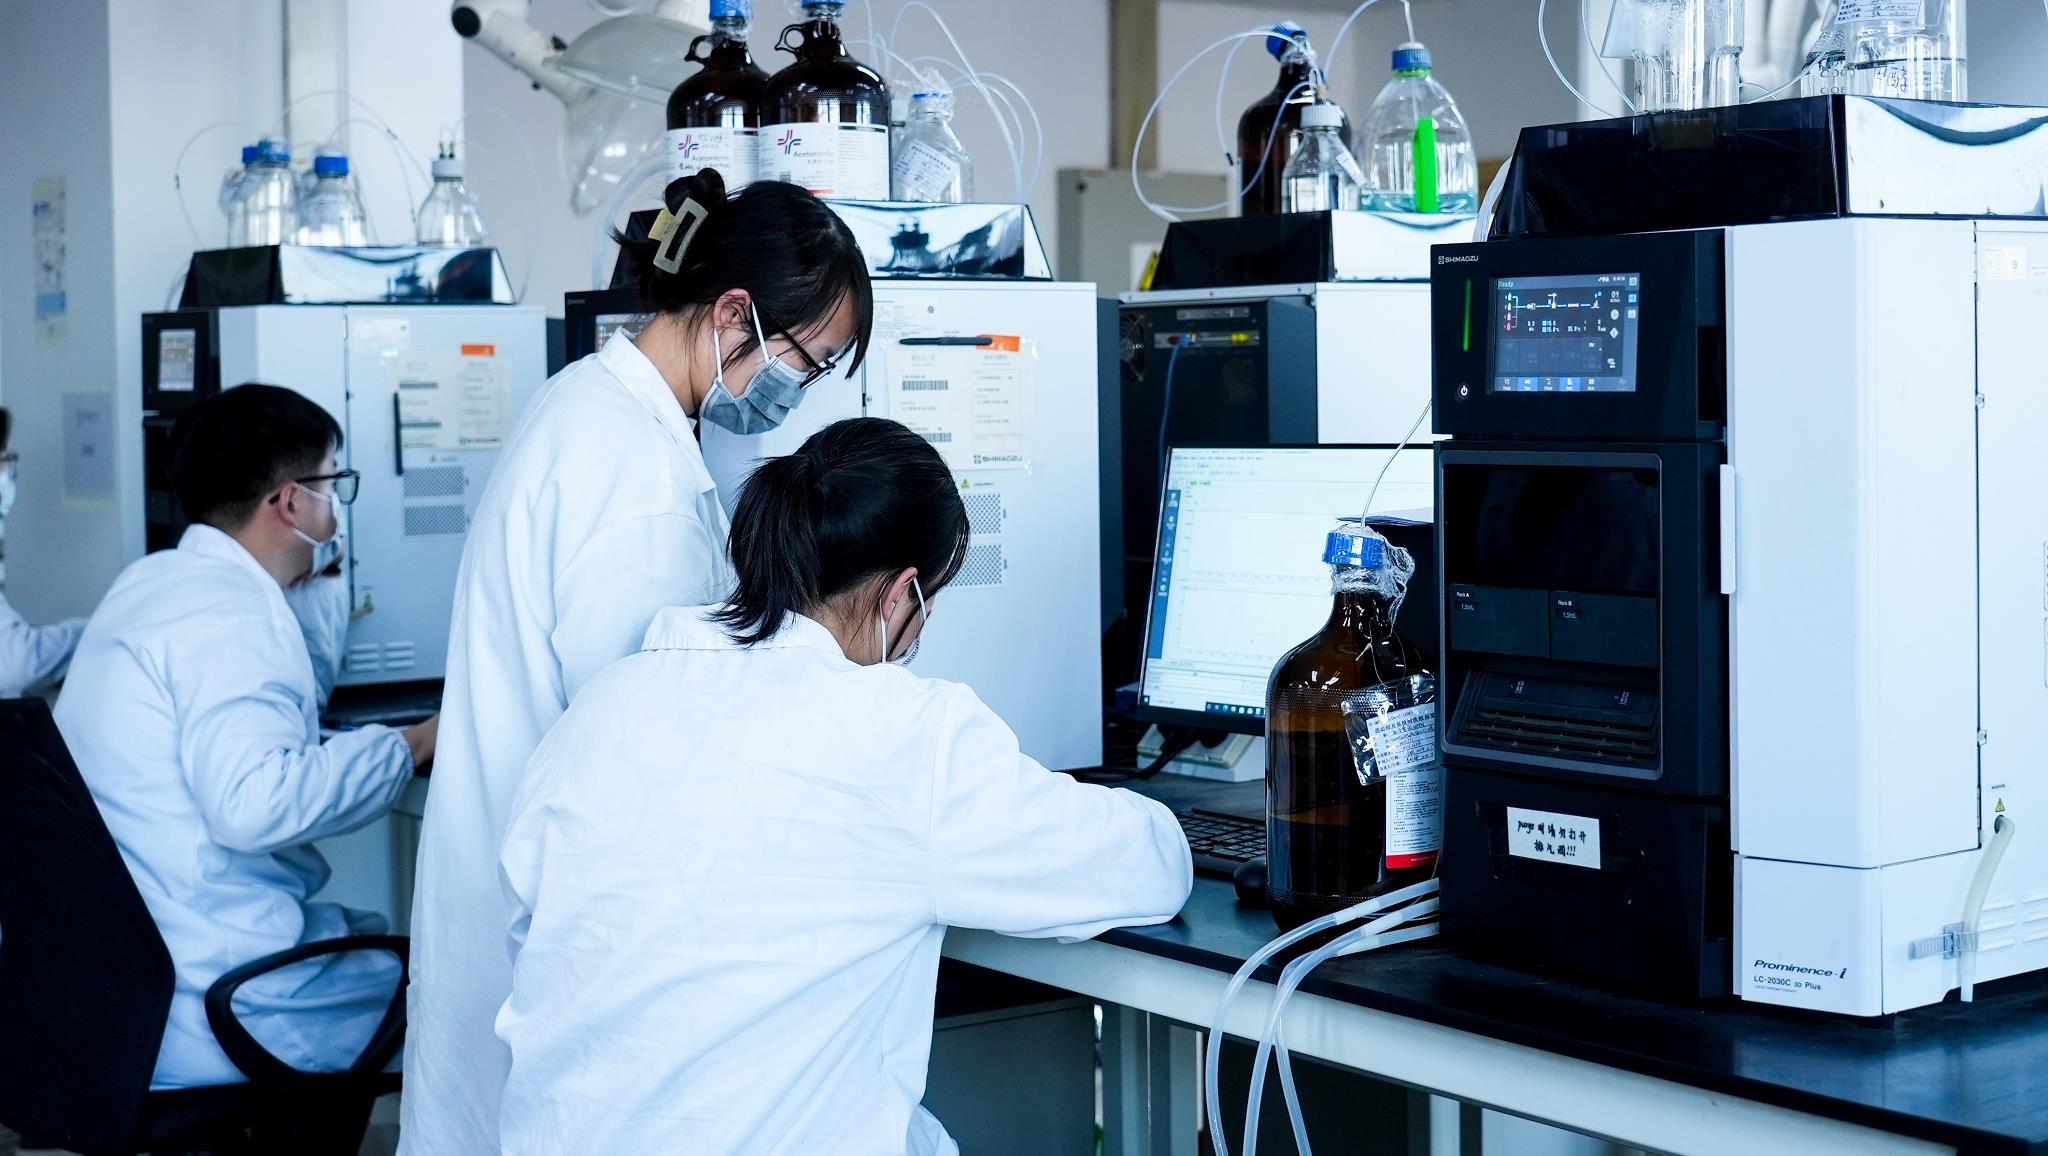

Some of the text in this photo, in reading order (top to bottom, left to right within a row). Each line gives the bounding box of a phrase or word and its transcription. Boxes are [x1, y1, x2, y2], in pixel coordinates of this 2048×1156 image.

[1444, 255, 1479, 263] SHIMADZU
[1753, 975, 1791, 986] LC-2030C
[1804, 981, 1822, 991] Plus
